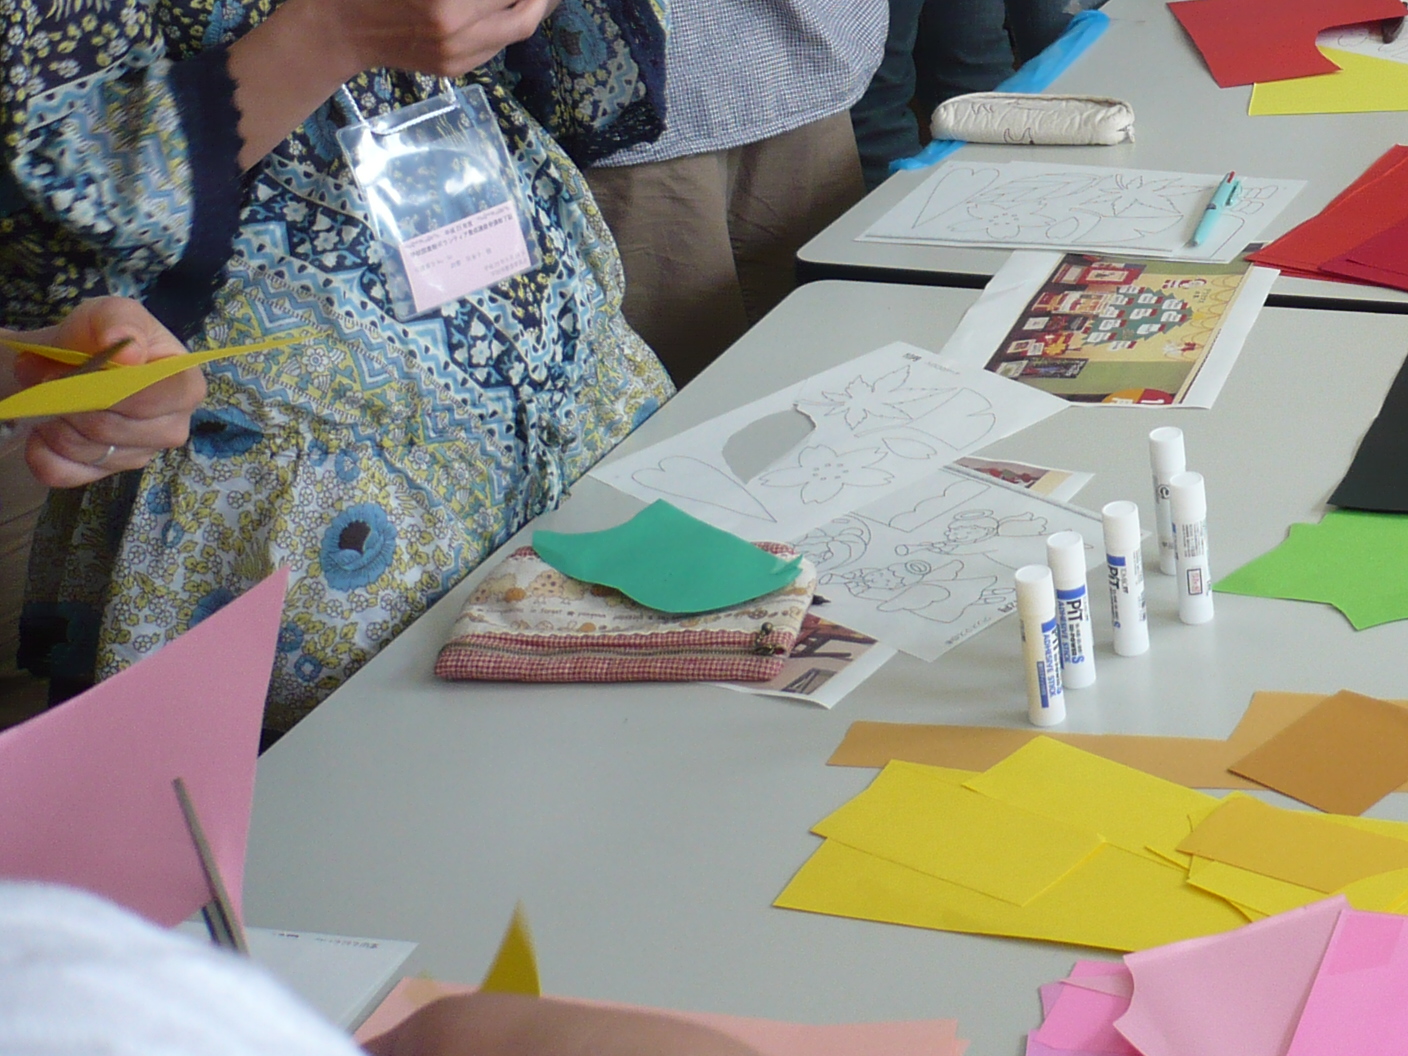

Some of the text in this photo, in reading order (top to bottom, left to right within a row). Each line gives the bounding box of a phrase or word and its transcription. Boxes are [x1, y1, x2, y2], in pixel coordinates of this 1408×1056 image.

[1044, 634, 1058, 697] ADHESIVE STICK
[1063, 642, 1072, 664] STICK
